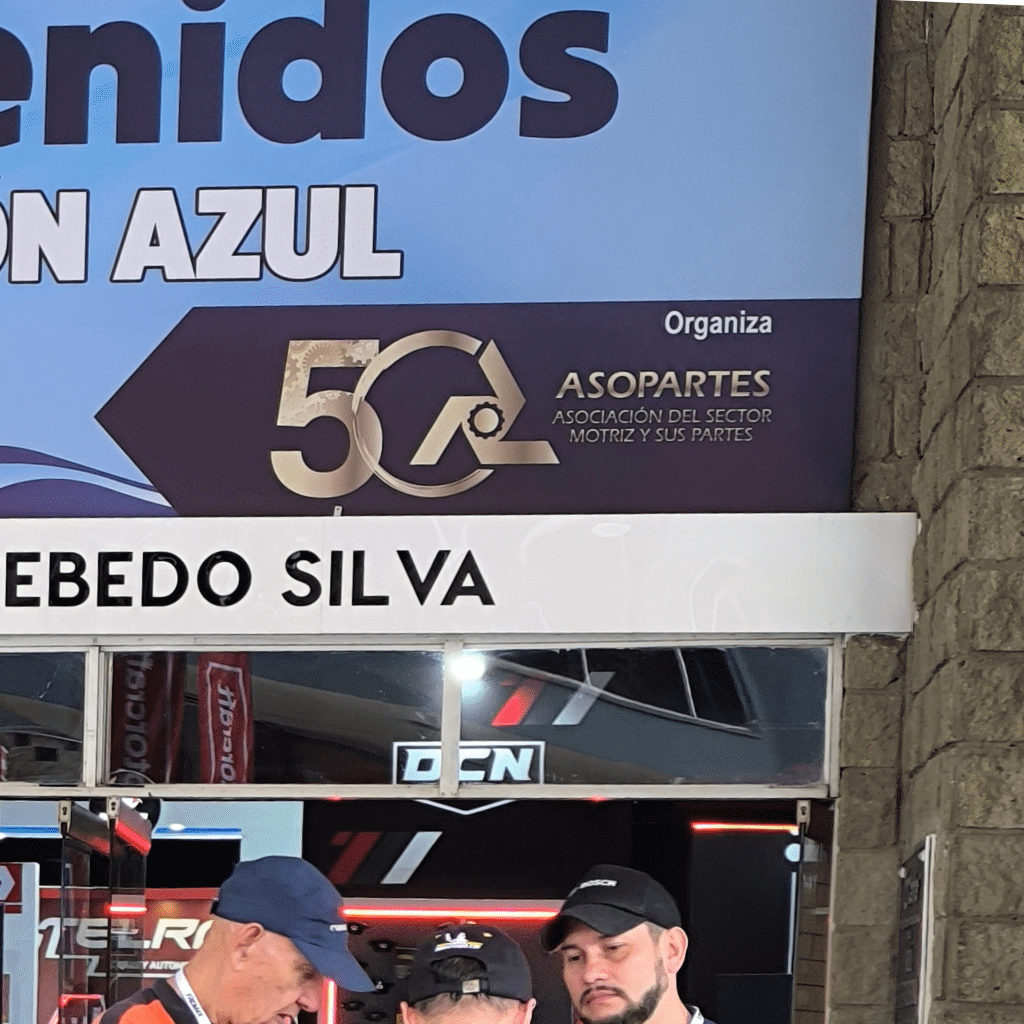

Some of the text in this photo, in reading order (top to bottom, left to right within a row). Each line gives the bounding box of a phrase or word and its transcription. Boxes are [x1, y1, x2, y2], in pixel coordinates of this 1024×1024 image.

[110, 184, 404, 283] AZUL
[664, 310, 773, 340] Organiza
[554, 370, 771, 399] ASOPARTES
[552, 406, 773, 424] ASOCIACIÓN DEL SECTOR
[569, 427, 754, 443] MOTRIZ Y SUS PARTES
[282, 548, 496, 607] SILVA
[403, 748, 534, 781] DCN
